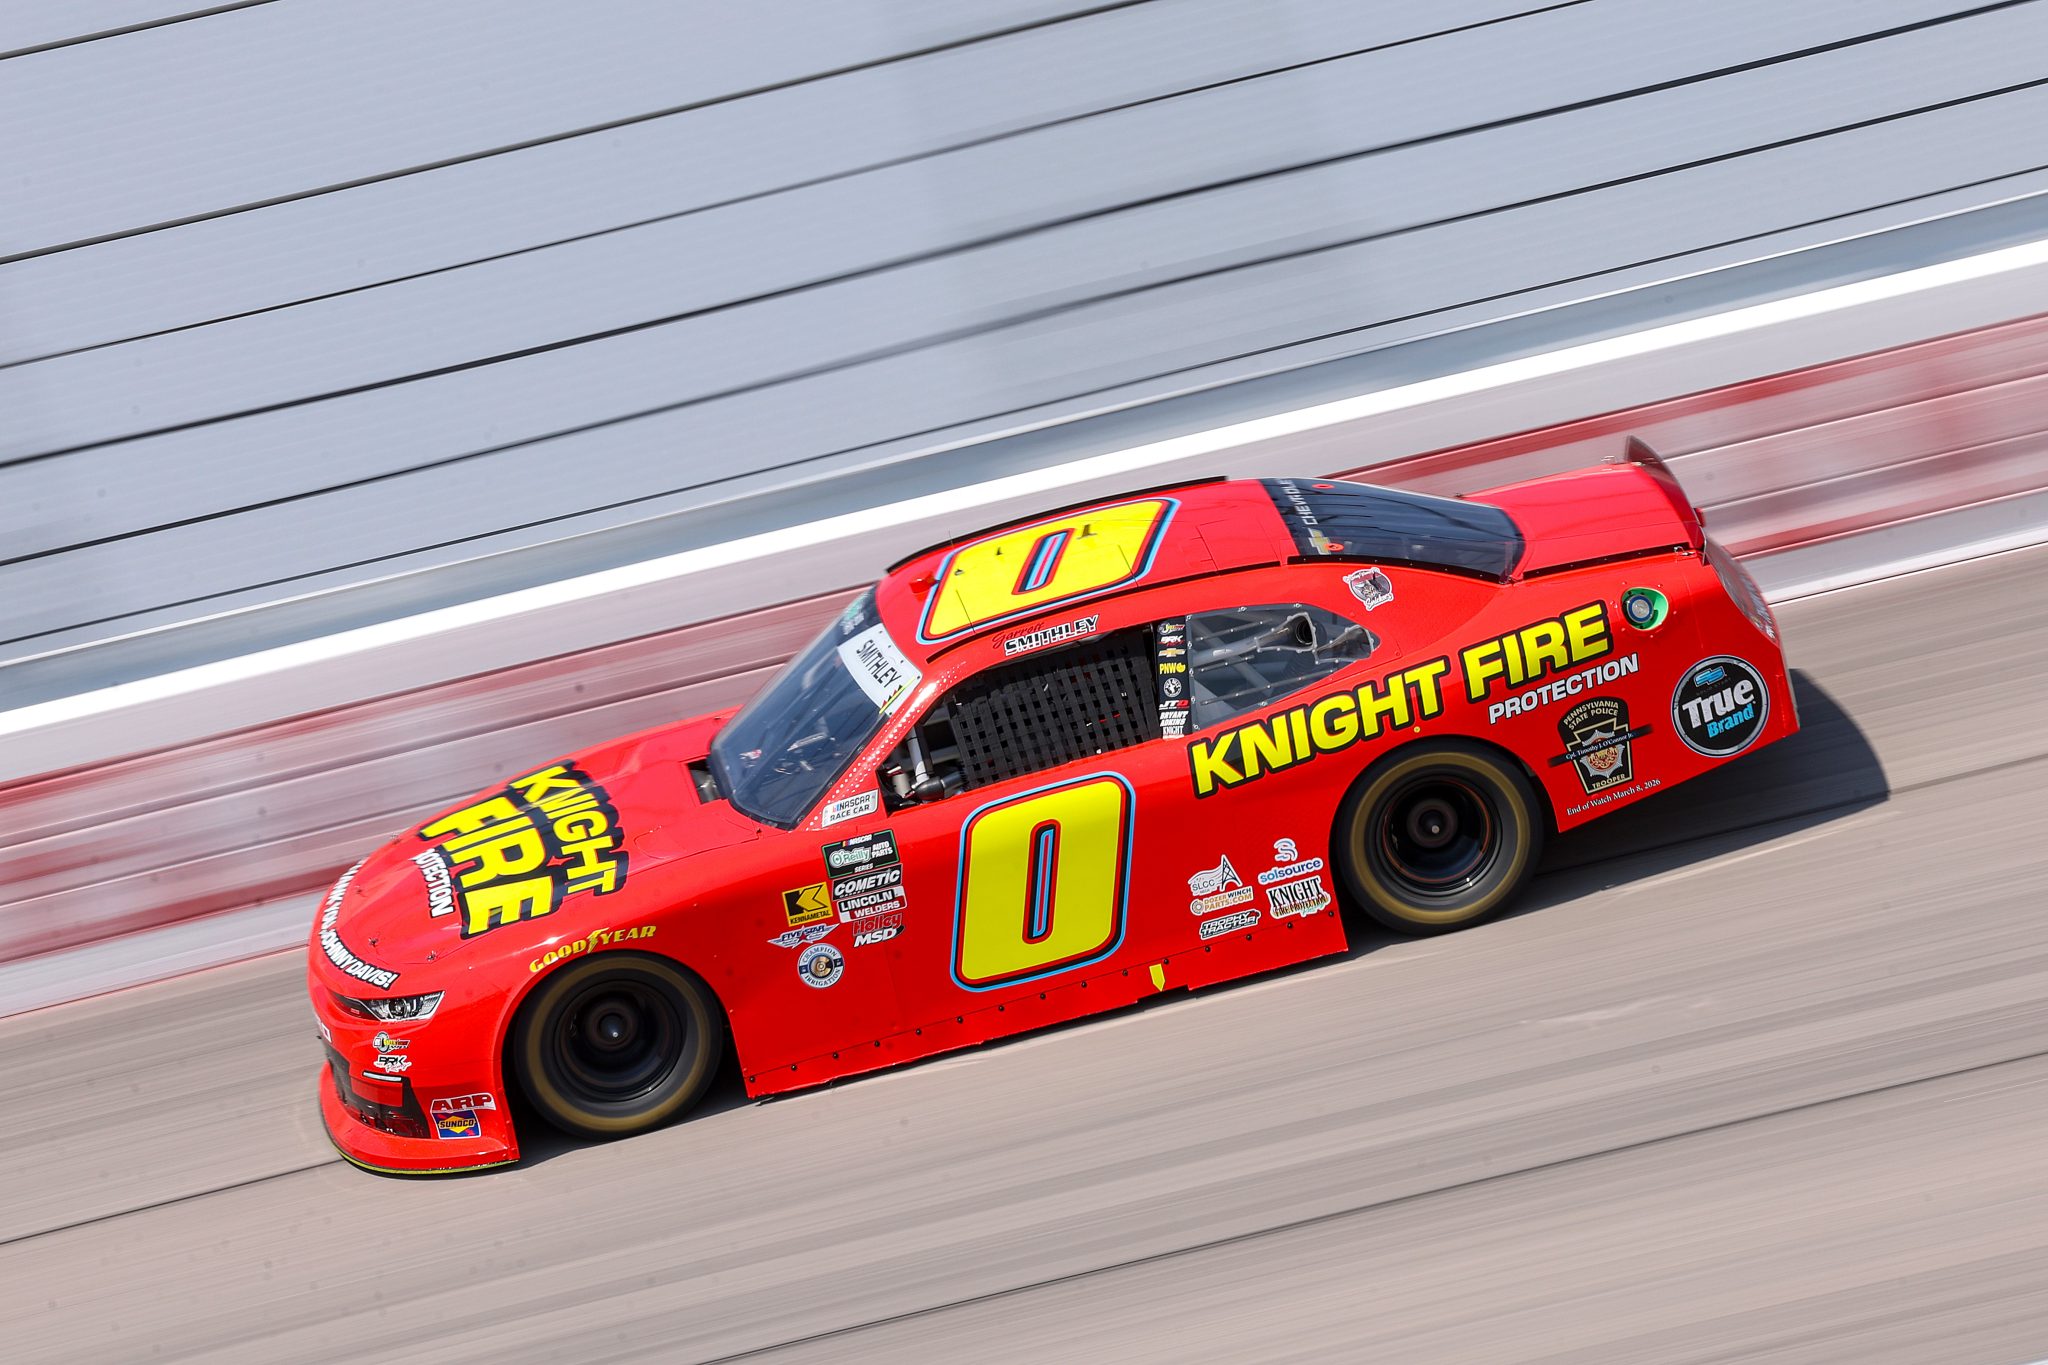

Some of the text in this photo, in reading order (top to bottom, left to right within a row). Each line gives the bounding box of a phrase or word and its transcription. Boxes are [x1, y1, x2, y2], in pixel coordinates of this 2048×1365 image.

[921, 499, 1175, 640] 0
[1004, 615, 1099, 656] SMITHLEY
[856, 639, 903, 688] SMITHLEY
[1191, 602, 1612, 797] KNIGHT FIRE
[1489, 653, 1639, 724] PROTECTION
[1563, 700, 1619, 725] PENNSYLVANIA
[1682, 679, 1755, 729] True
[1568, 708, 1618, 730] STATE POLICE
[1706, 703, 1755, 738] Brand
[1592, 773, 1626, 789] TROOPER
[837, 795, 871, 811] NASCAR
[1567, 778, 1661, 816] End of Watch March 8, 2026
[830, 804, 870, 821] RACE CAR
[509, 764, 619, 895] KNIGHT
[871, 847, 893, 858] PARTS
[872, 841, 890, 851] AUTO
[419, 797, 554, 936] FIRE
[854, 863, 874, 872] SERIES
[1260, 860, 1321, 883] solsource
[409, 848, 454, 917] OTECTION
[834, 869, 901, 896] COMETIC
[953, 773, 1133, 989] 0
[1192, 879, 1215, 891] SLCC
[841, 891, 892, 911] LINCOLN
[1204, 894, 1226, 905] DOZER
[1227, 888, 1251, 898] WINCH
[1205, 893, 1252, 911] PARTS.COM
[1268, 877, 1320, 908] KNIGHT
[854, 901, 900, 917] WELDERS
[853, 913, 902, 936] Holley
[1201, 916, 1256, 935] TRACTOR
[1203, 912, 1250, 930] TROPHY
[781, 930, 801, 942] FIVE
[853, 927, 898, 947] MSD
[529, 926, 657, 972] GOODYEAR
[802, 946, 837, 963] CHAMPION
[344, 959, 400, 989] DAVIS!
[804, 967, 842, 987] IRRIGATION
[431, 1095, 492, 1110] ARP
[440, 1119, 474, 1128] SUNOCO
